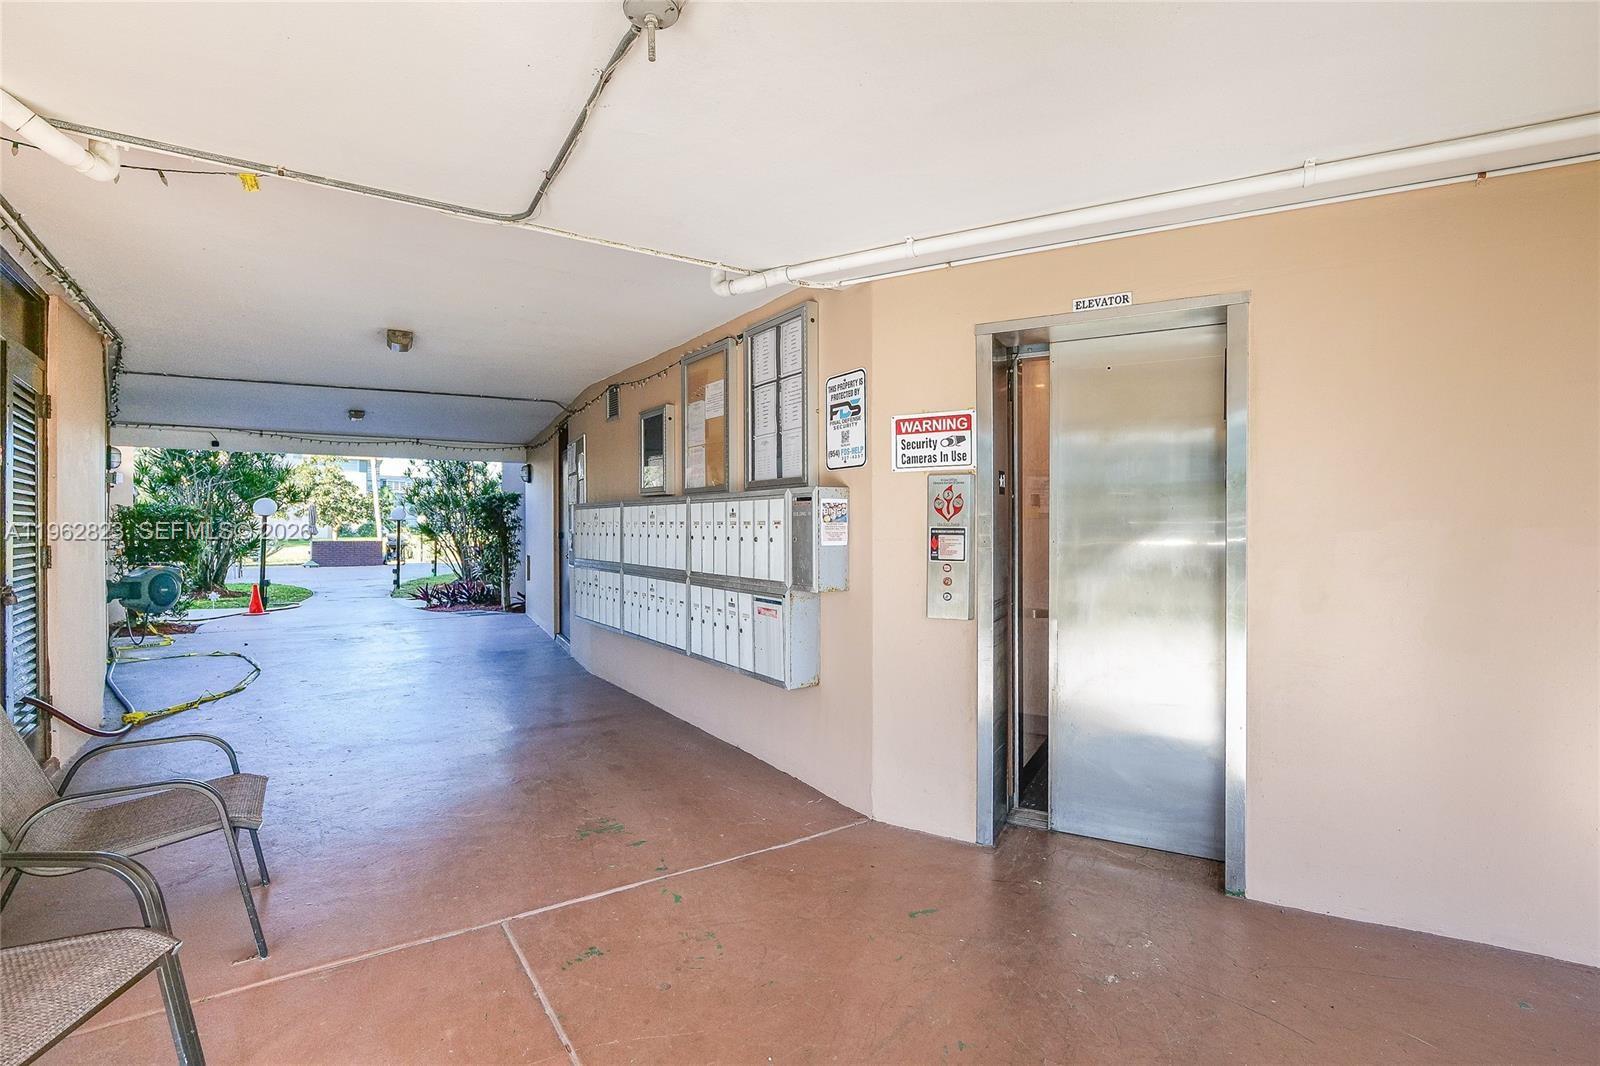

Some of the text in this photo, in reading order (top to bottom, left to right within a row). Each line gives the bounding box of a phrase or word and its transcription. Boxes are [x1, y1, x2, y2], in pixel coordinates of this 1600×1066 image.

[1075, 294, 1130, 310] ELEVATOR
[828, 377, 863, 393] THIS PROPERTY IS
[831, 388, 860, 401] PROTECTED BY
[833, 422, 858, 430] SECURITY
[900, 417, 968, 433] WARNING
[900, 437, 938, 450] Security
[901, 451, 967, 465] Cameras In Use
